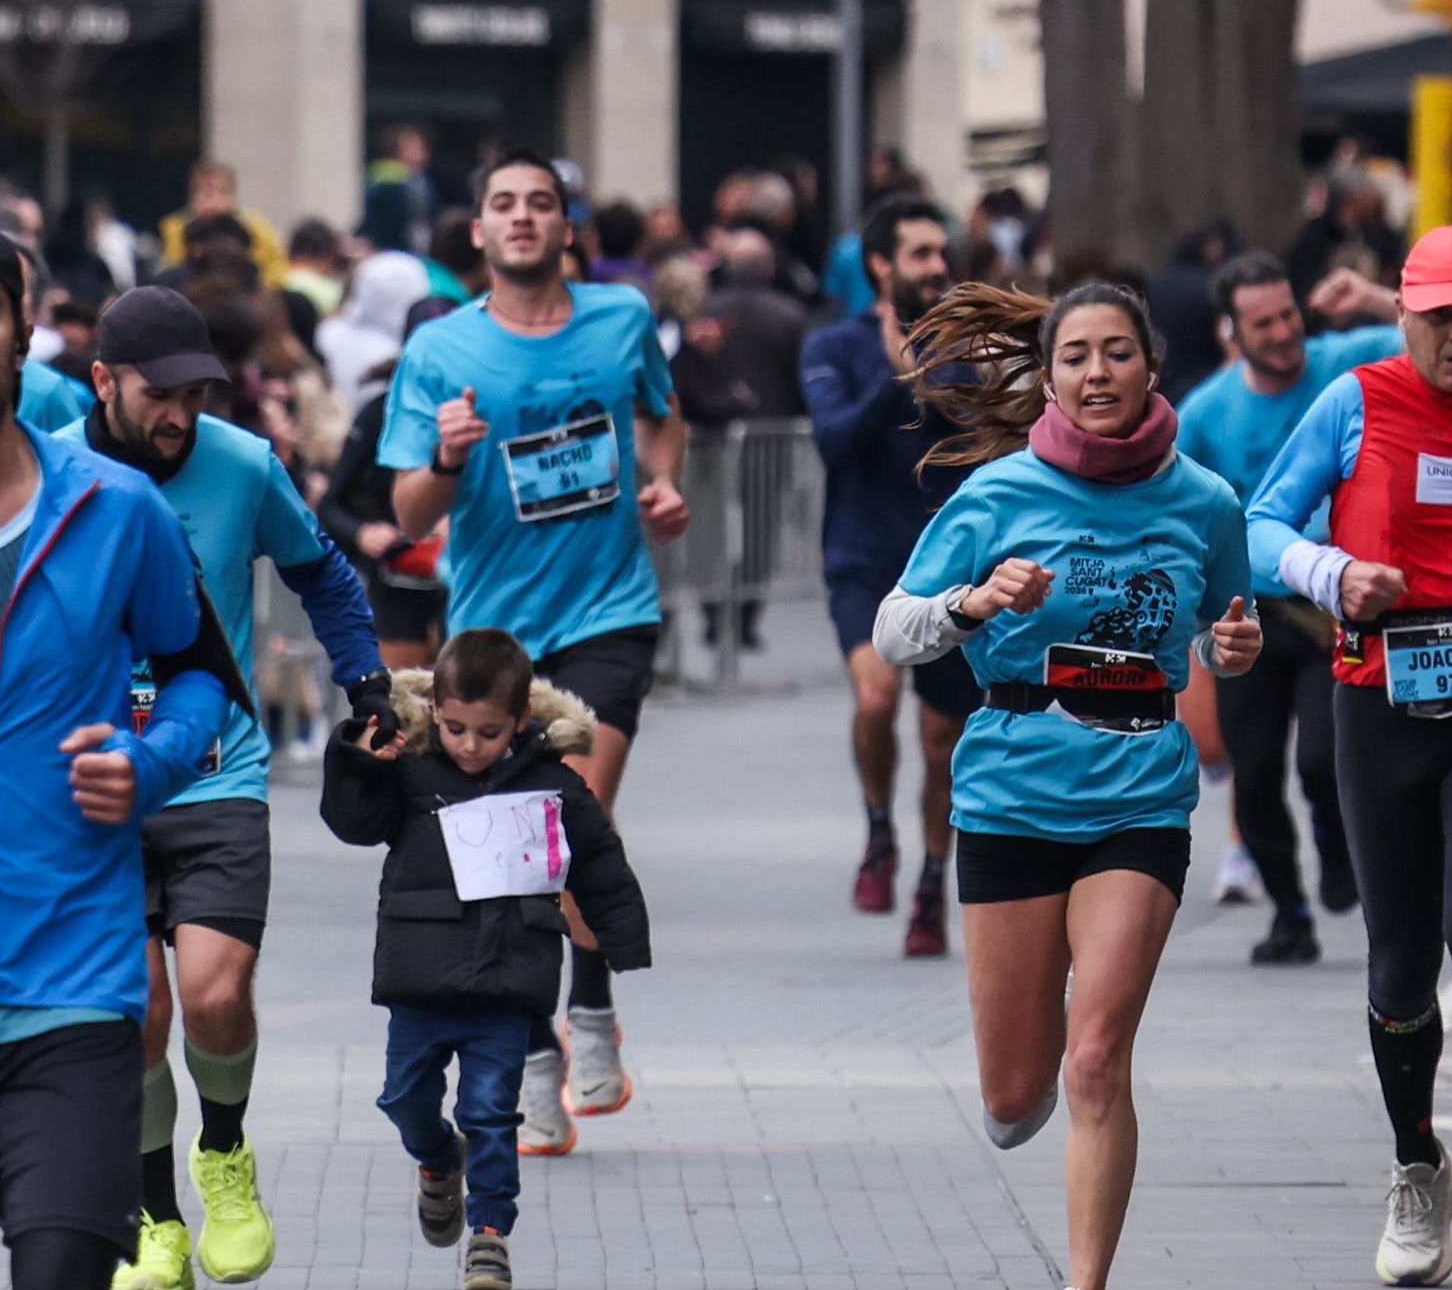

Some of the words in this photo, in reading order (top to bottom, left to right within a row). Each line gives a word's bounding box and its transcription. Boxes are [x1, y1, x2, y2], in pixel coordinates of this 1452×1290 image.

[1069, 557, 1106, 568] MITJA
[1070, 567, 1104, 577] SANT
[1065, 576, 1109, 587] CUGAT
[1064, 587, 1088, 595] 2026
